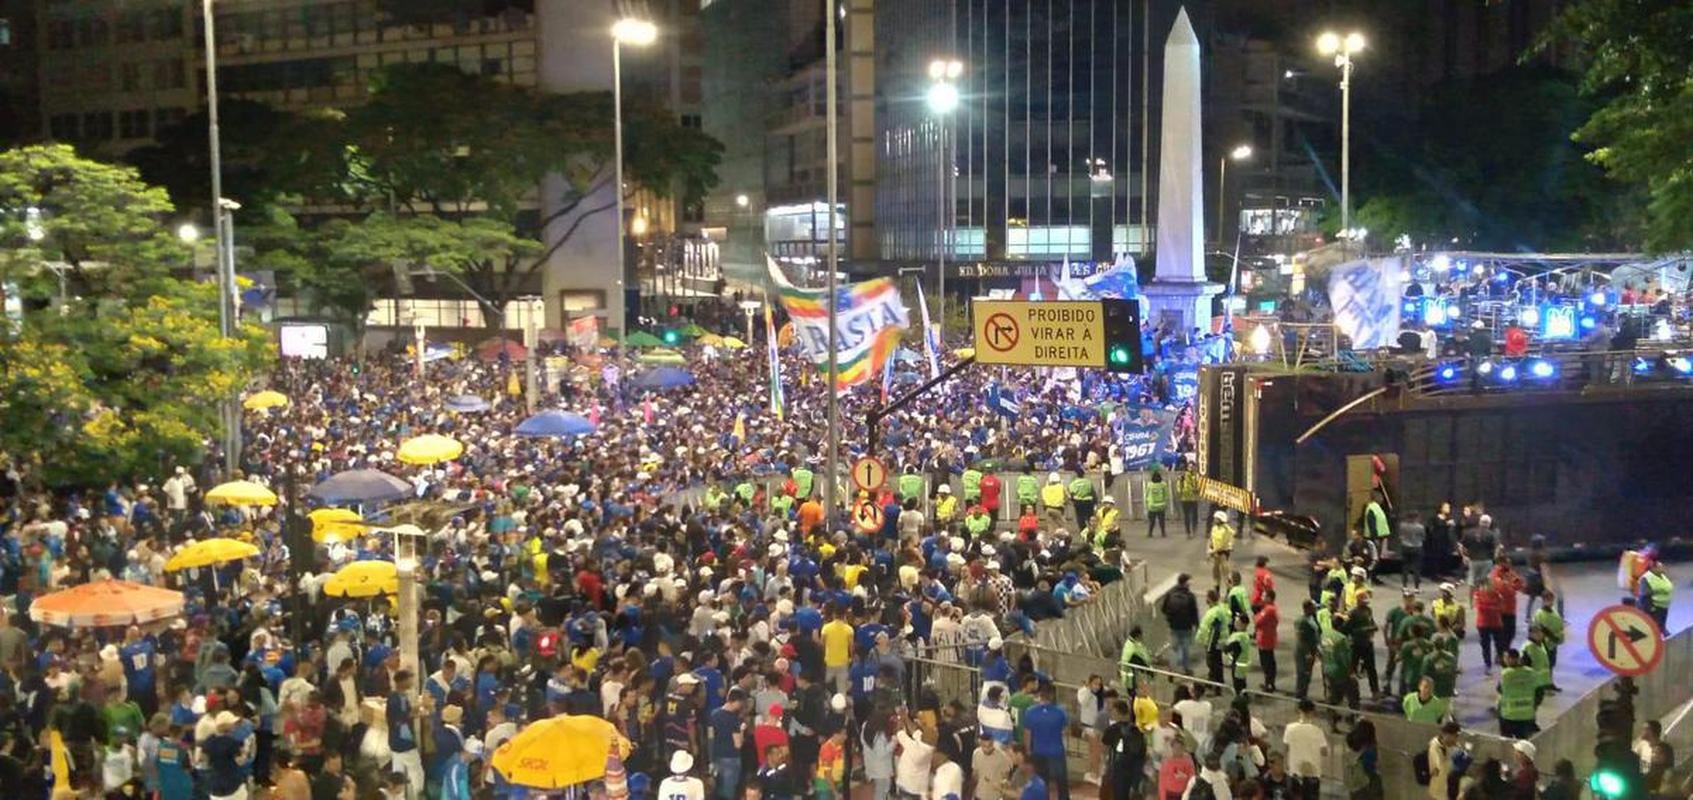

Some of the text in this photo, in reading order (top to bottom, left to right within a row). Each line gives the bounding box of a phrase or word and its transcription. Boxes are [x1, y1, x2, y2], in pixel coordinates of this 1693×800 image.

[1028, 308, 1096, 323] PROIBIDO
[1030, 327, 1075, 341] VIRAR
[1034, 345, 1090, 359] DIREITA
[1124, 441, 1157, 461] 1967
[863, 675, 875, 692] 10
